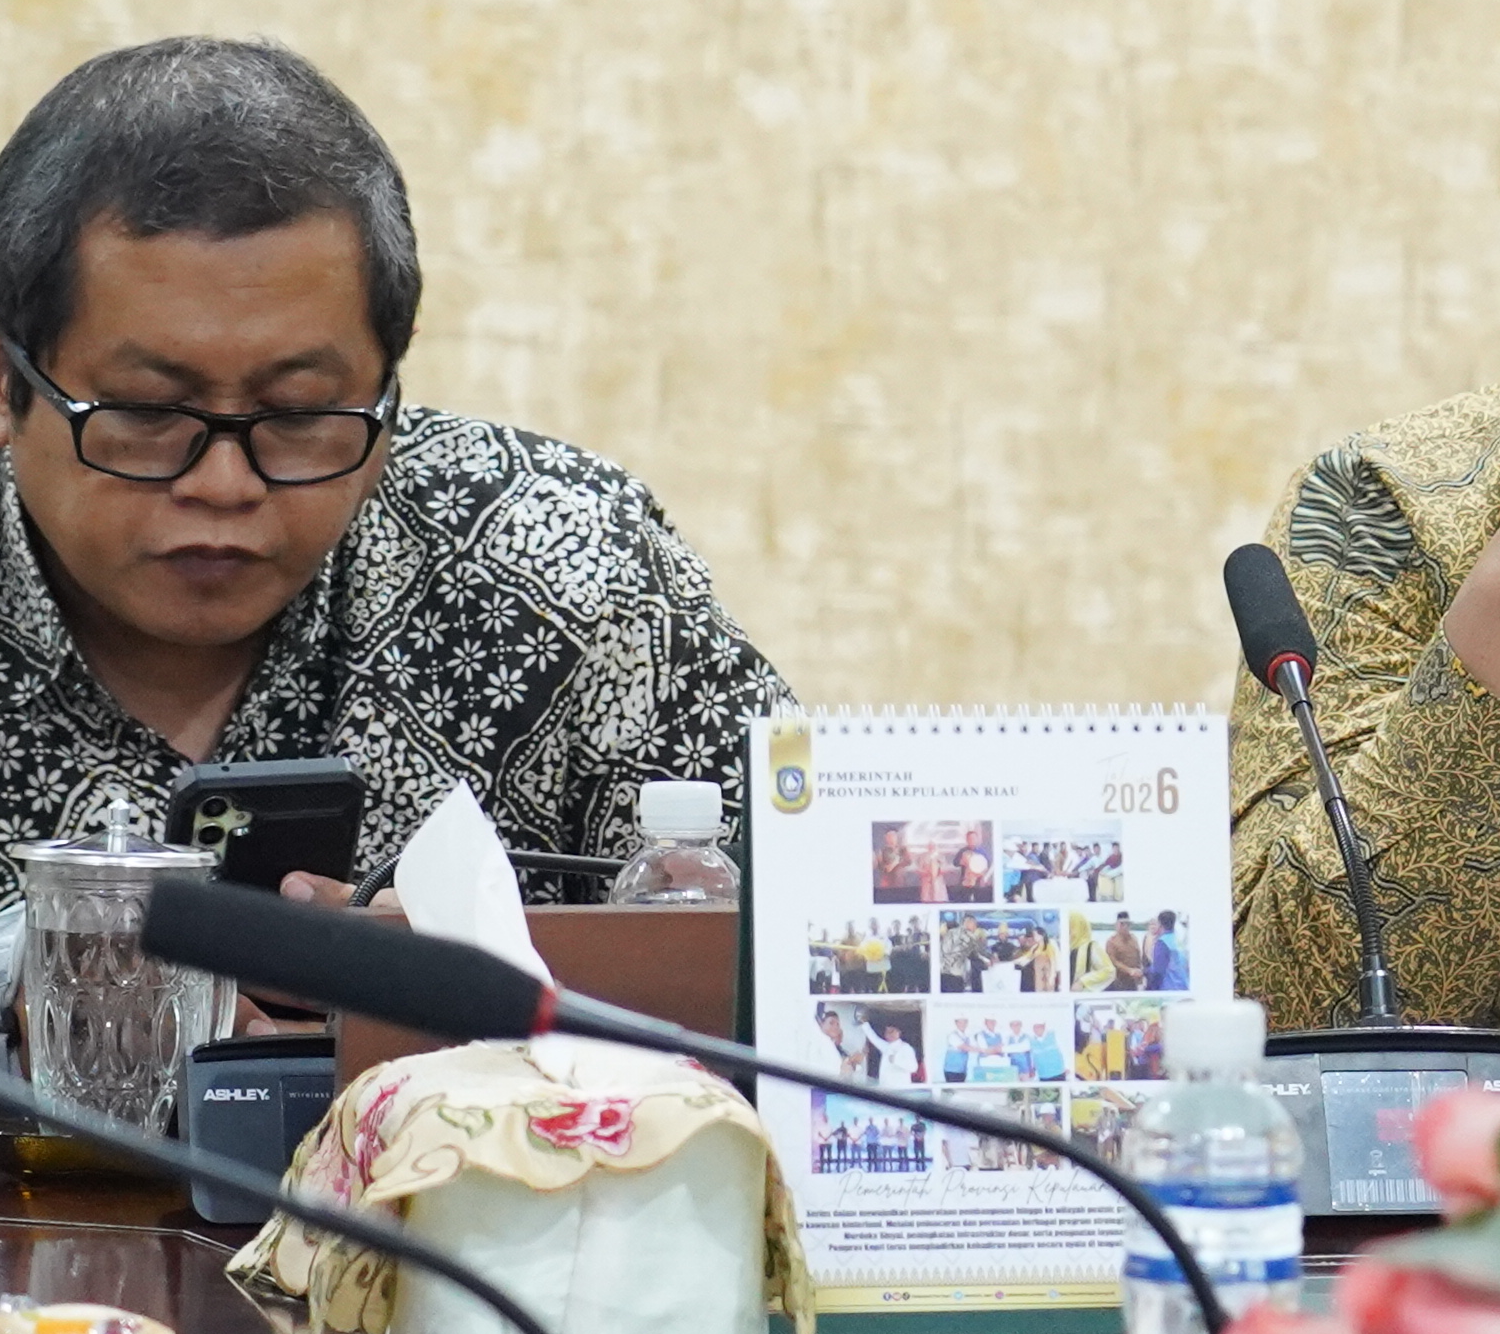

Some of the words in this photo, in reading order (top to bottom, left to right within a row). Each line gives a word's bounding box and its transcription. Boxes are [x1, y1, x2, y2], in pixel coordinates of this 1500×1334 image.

[817, 771, 913, 782] PEMERINTAH
[817, 787, 887, 798] PROVINSI
[892, 786, 979, 797] KEPULAUAN
[984, 786, 1019, 797] RIAU
[1102, 766, 1179, 814] 2026
[1259, 1083, 1310, 1096] HLEY
